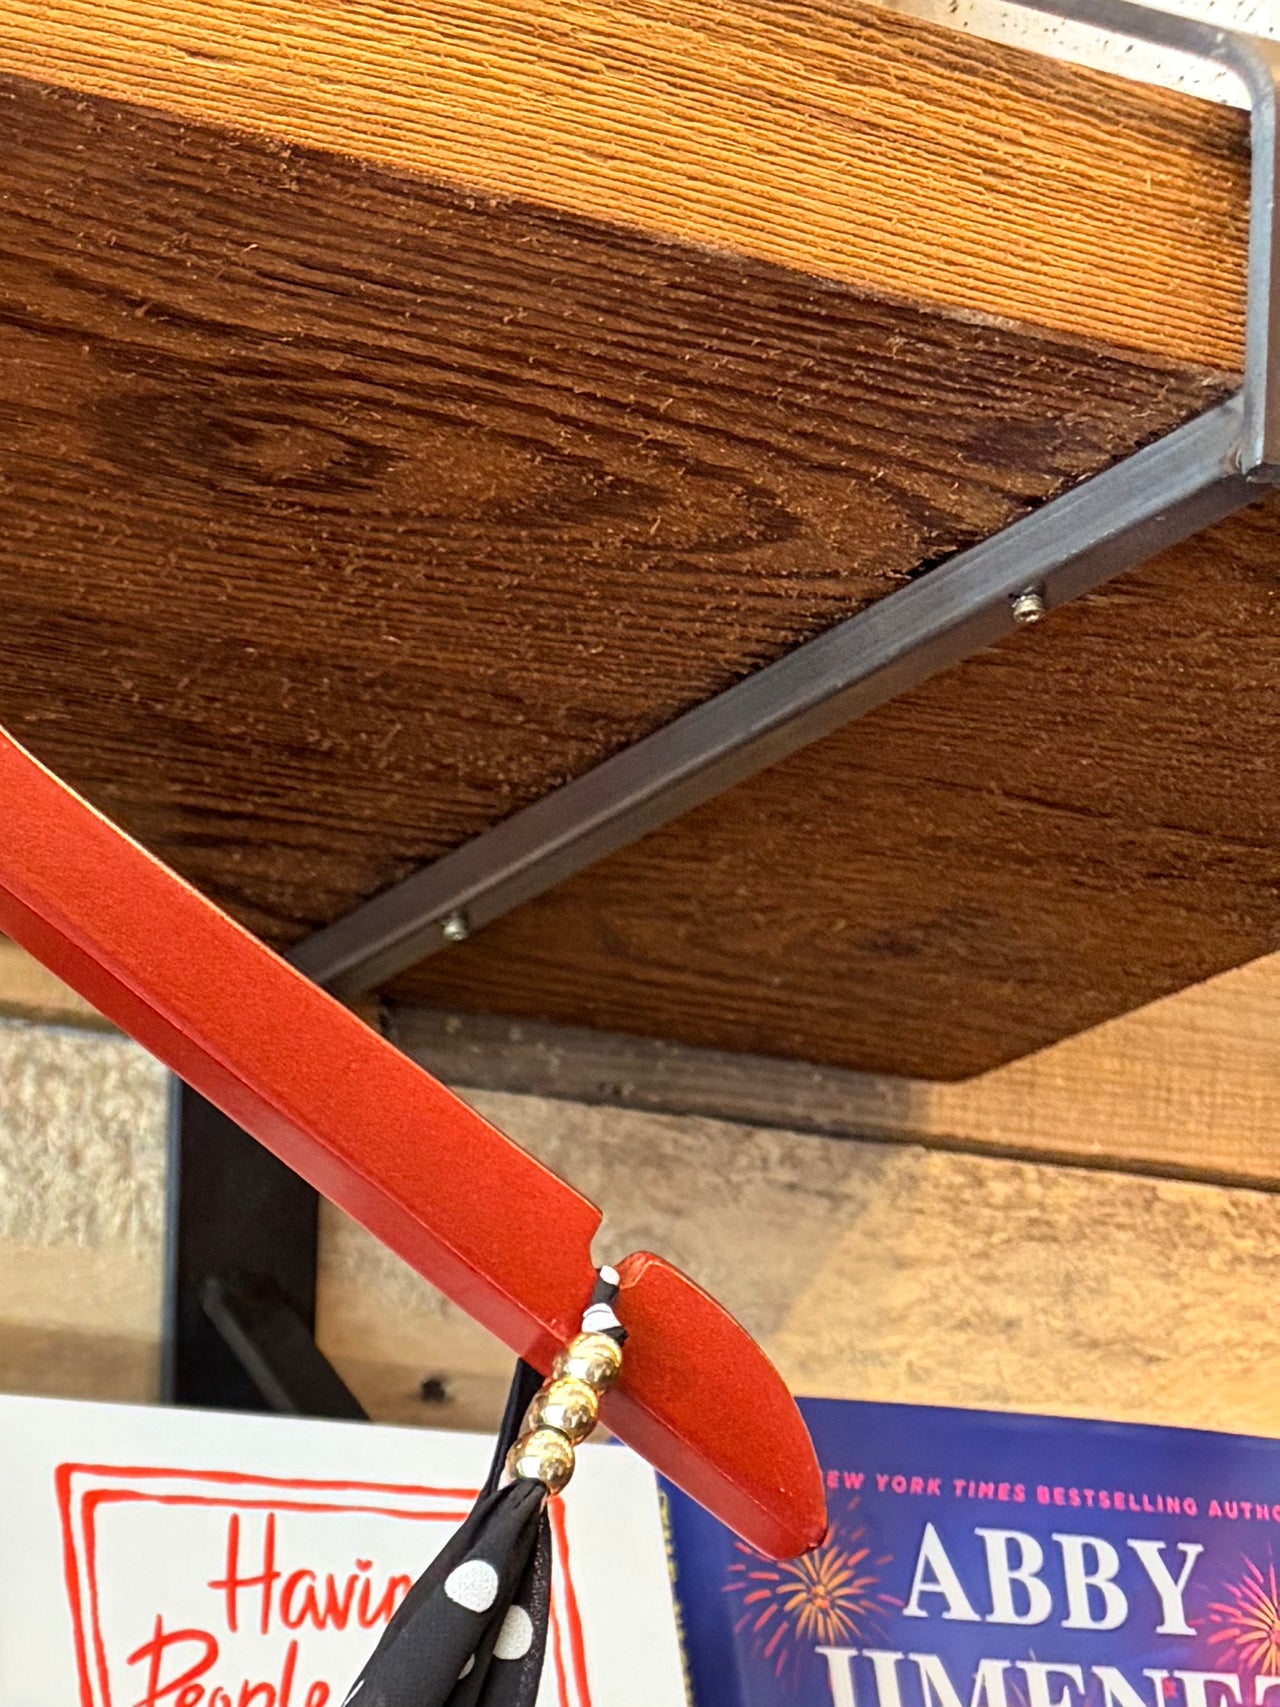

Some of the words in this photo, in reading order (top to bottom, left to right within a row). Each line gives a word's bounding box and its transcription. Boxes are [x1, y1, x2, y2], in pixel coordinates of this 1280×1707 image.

[826, 1470, 865, 1490] EW
[875, 1473, 941, 1496] YORK
[953, 1478, 1026, 1502] TIMES
[1037, 1485, 1199, 1516] BESTSELLING
[208, 1512, 412, 1637] Havin
[901, 1521, 1204, 1637] ABBY
